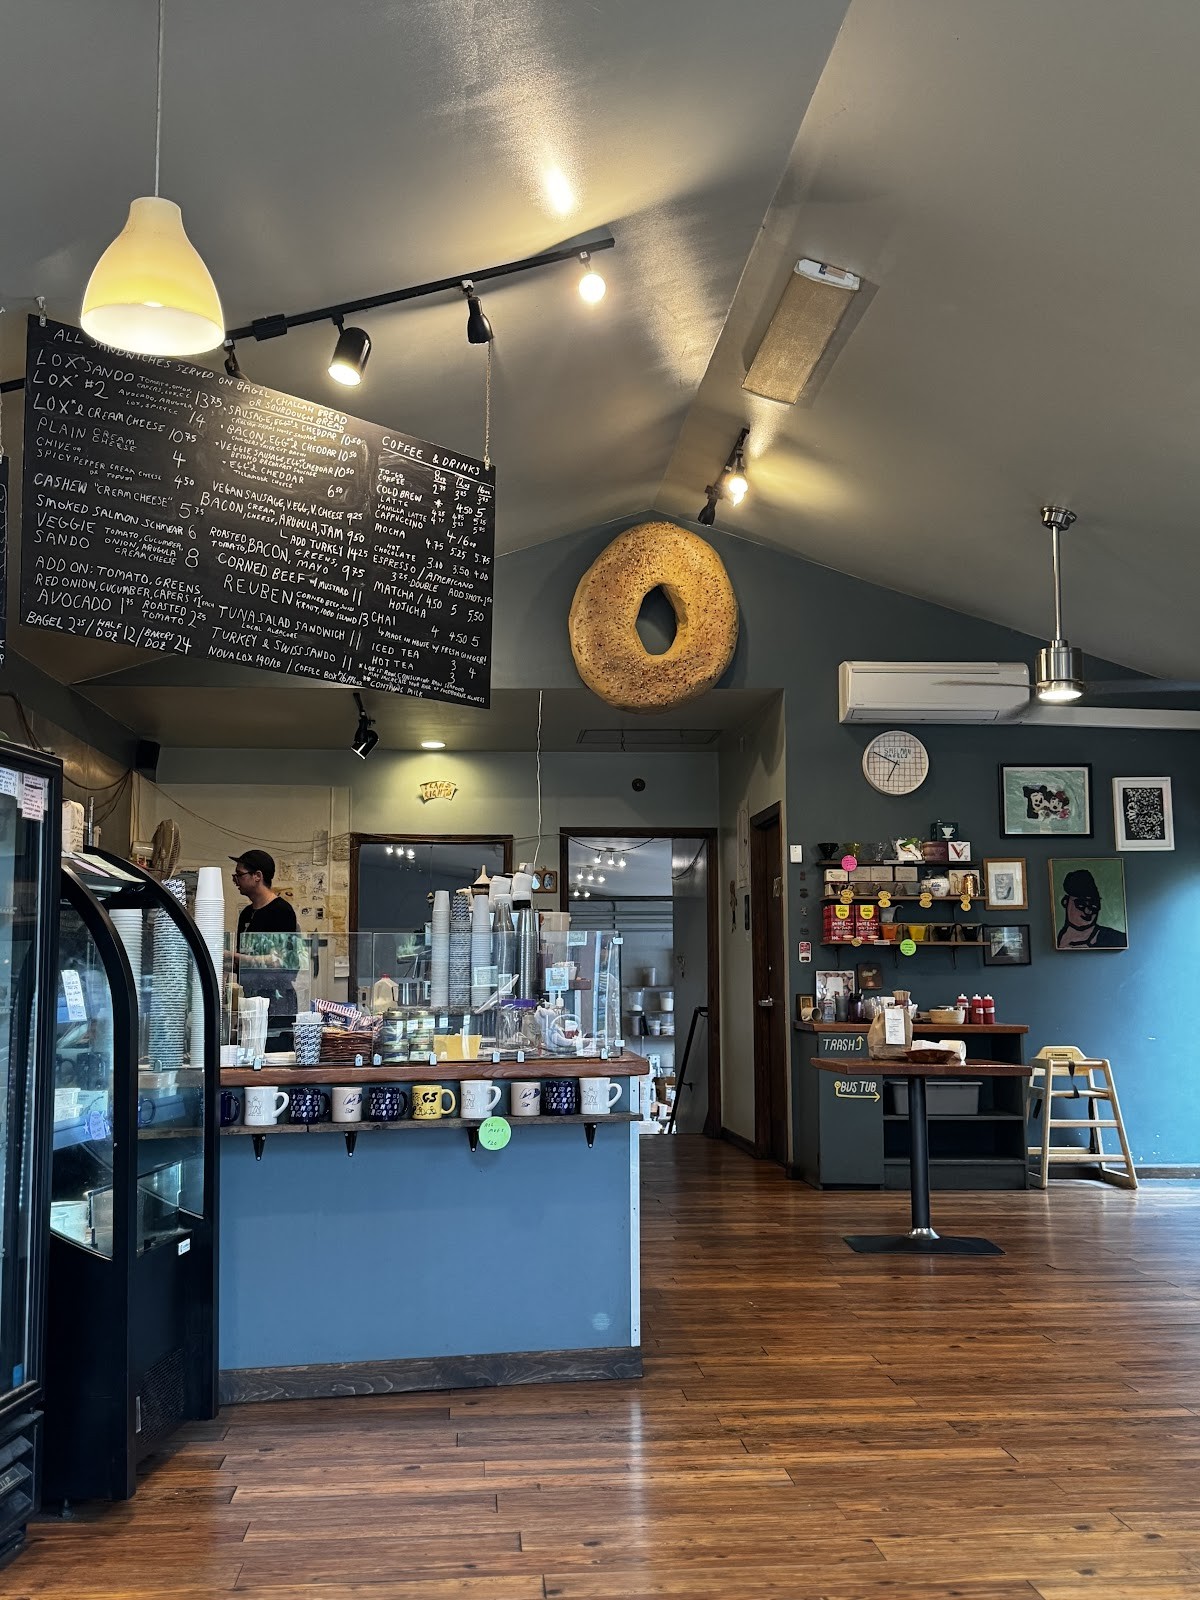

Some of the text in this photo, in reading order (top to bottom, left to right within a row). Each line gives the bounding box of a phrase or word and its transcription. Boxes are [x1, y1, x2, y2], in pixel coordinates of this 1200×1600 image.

[54, 328, 83, 344] ALL
[176, 364, 214, 379] SERVED
[276, 398, 314, 412] CHALLAH
[318, 408, 347, 424] BREAD
[84, 361, 134, 382] SANDO
[85, 379, 206, 428] #2 14
[88, 407, 165, 432] CREAM CHEESE
[266, 403, 313, 422] SOURDOUGH
[316, 417, 344, 431] BREAD
[37, 417, 186, 468] PLAIN CREAM 4
[302, 426, 336, 439] CHEDDAR
[36, 437, 70, 451] CHIVE
[92, 436, 137, 452] CHEESE
[302, 443, 337, 457] CHEDDAR
[37, 449, 161, 480] SPICY PEPPER CREAM CHEESE
[220, 440, 251, 454] VEGGIE
[302, 461, 333, 474] CHEDDAR
[231, 452, 256, 462] BEYOND
[382, 436, 480, 475] COFFEE & DRINKS
[34, 473, 87, 494] CASHEW
[261, 467, 304, 484] CHEDDAR
[378, 474, 405, 485] COFFEE
[212, 480, 243, 497] VEGAN
[377, 485, 486, 517] COLD BREW 5
[381, 496, 408, 507] LATTE
[36, 494, 197, 539] SMOKED SALMON SCHMEAR 6
[248, 503, 275, 515] CREAM
[320, 524, 343, 540] JAM
[375, 510, 423, 529] CAPPUCCINO
[378, 504, 427, 522] VANILLA LATTE
[34, 530, 89, 548] SANDO
[37, 512, 199, 568] VEGGIE 8
[209, 527, 246, 543] ROASTED
[375, 523, 406, 539] MOCHA
[290, 535, 343, 556] ADD TURKEY
[374, 545, 416, 562] CHOCOLATE
[35, 556, 66, 570] ADD
[115, 548, 177, 565] CREAM CHEESE
[297, 560, 328, 574] MAYO
[218, 552, 349, 596] CORNED BEEF MUSTARD
[373, 555, 473, 589] ESPRESSO AMERICANO
[35, 573, 58, 586] RED
[154, 589, 188, 602] CAPERS
[224, 574, 294, 605] REUBEN
[374, 581, 458, 615] MATCHA 5
[448, 588, 464, 598] ADD
[37, 589, 186, 616] AVOCADO ROASTED
[389, 598, 426, 618] HOJICHA
[142, 611, 183, 625] TOMATO
[219, 605, 345, 640] TUNA SALAD SANDWICH
[242, 623, 262, 631] LOCAL
[26, 611, 192, 654] BAGEL HALF 12 BAKERS 24
[96, 628, 166, 650] DOZ DOZ
[372, 612, 480, 647] CHAI 4 5
[212, 626, 257, 647] TURKEY
[274, 640, 303, 656] SWISS
[304, 647, 335, 662] SANDO
[385, 631, 402, 640] MADE
[412, 639, 429, 648] HOUSE
[441, 646, 459, 656] FRESH
[208, 645, 234, 659] NOVA
[236, 653, 253, 662] LOX
[294, 663, 320, 676] COFFEE
[324, 671, 337, 680] BOX
[372, 643, 476, 679] ICED TEA 3 4
[372, 656, 389, 667] HOT
[394, 660, 413, 670] TEA
[823, 1039, 855, 1050] TRASH
[840, 1081, 876, 1092] BUS TUB
